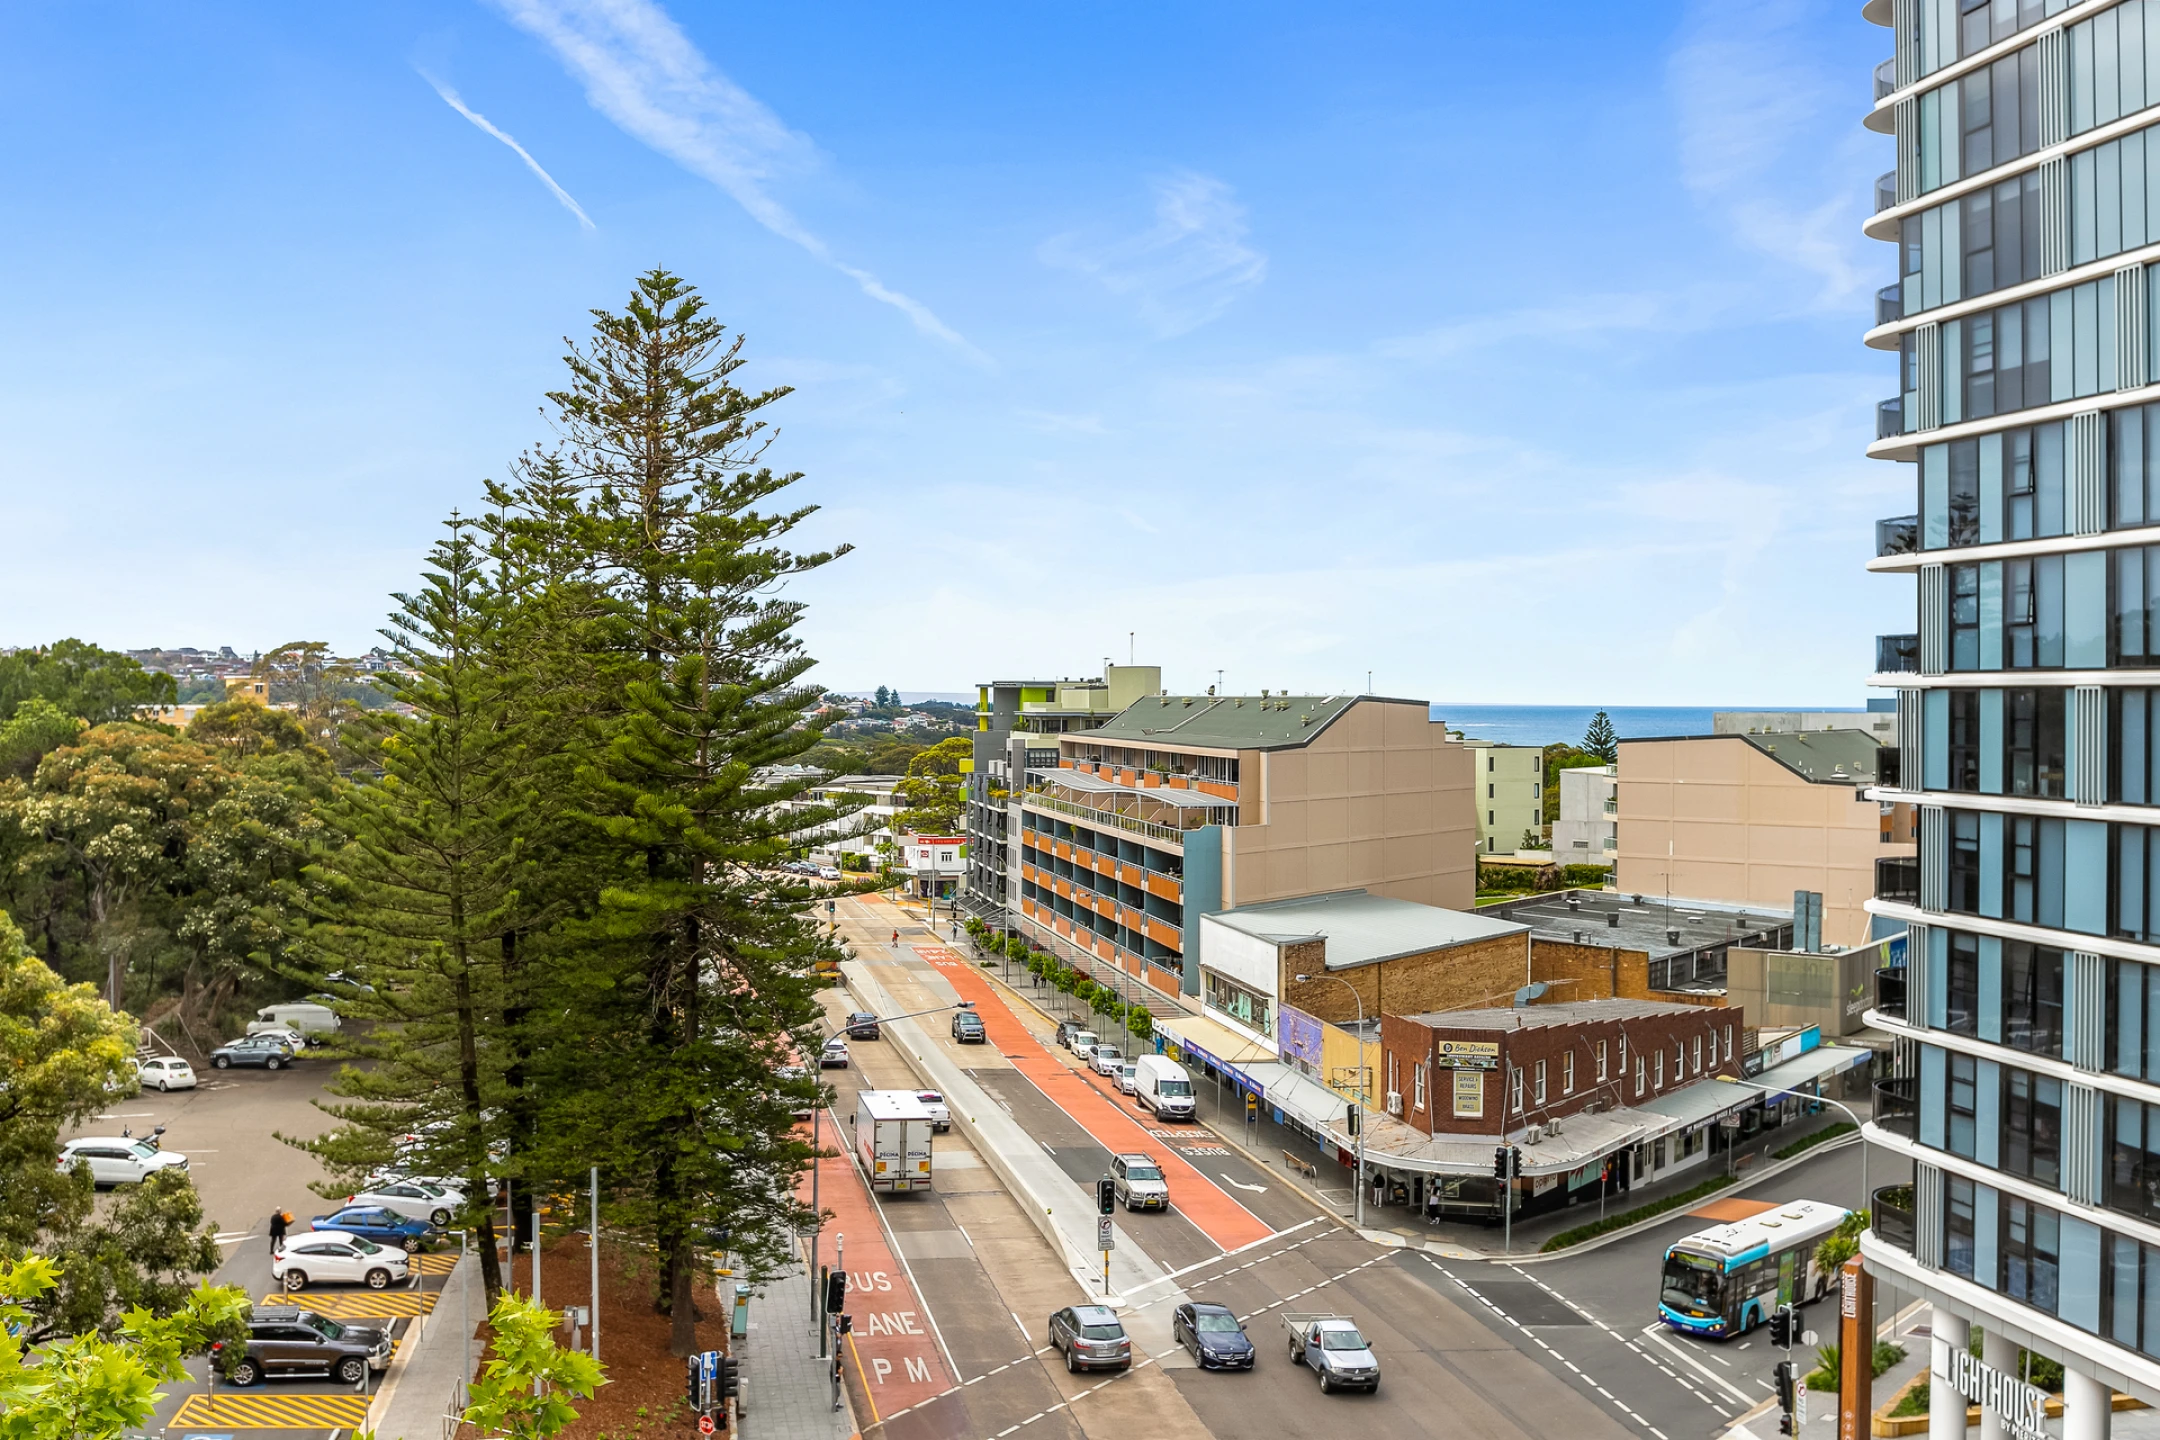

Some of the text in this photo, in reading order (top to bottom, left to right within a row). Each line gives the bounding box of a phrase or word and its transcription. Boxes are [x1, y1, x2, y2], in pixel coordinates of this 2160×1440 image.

[1180, 1147, 1232, 1156] BUSES
[850, 1311, 925, 1337] LANE
[1944, 1344, 2049, 1440] LIGHTHOUSE
[2000, 1418, 2011, 1433] BY
